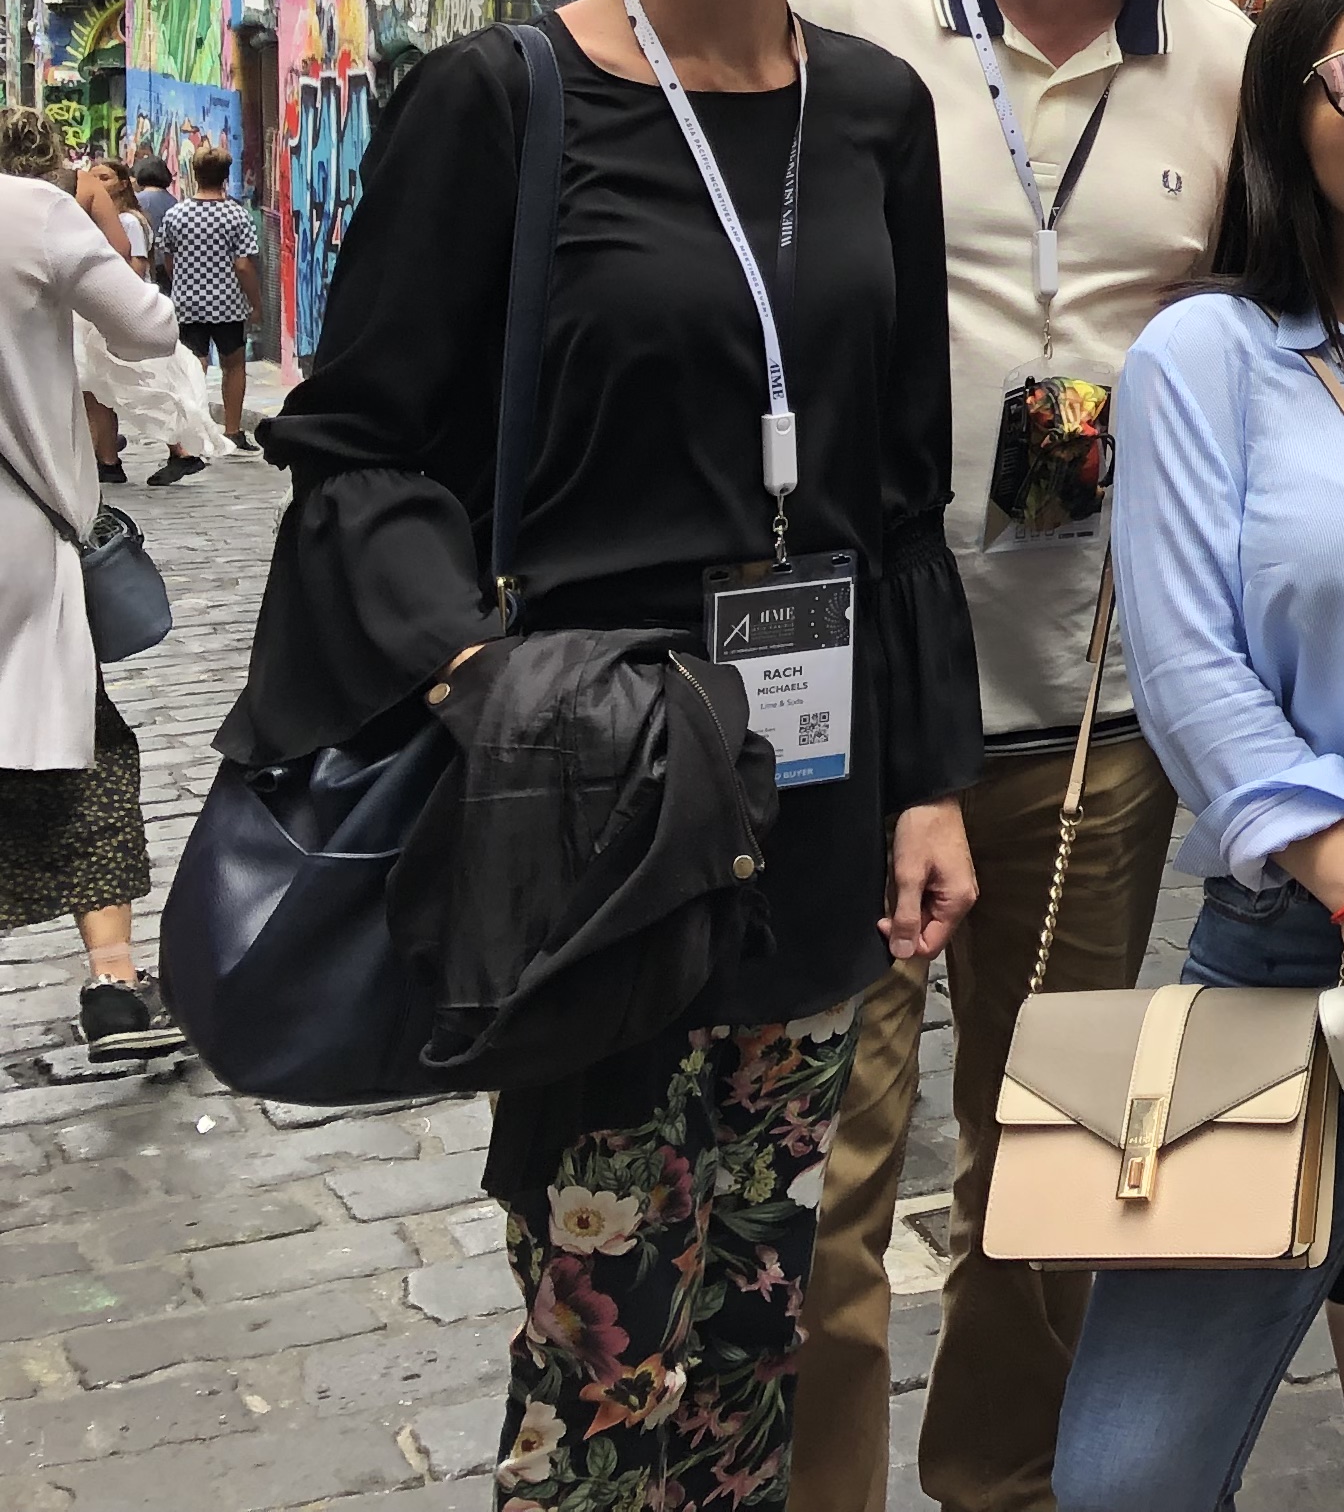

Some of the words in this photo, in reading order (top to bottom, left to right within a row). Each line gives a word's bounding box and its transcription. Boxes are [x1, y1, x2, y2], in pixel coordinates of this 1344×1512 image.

[683, 116, 696, 138] ASIA
[693, 138, 712, 171] PACIFIC
[708, 172, 733, 224] INCENTIVES
[729, 225, 742, 243] AND
[739, 244, 760, 288] MEETINGS
[757, 289, 769, 318] EVENT
[780, 209, 793, 248] WHEN
[768, 357, 785, 401] AIME
[763, 665, 804, 681] RACH
[757, 681, 809, 696] MICHAELS
[783, 767, 814, 779] BUYER
